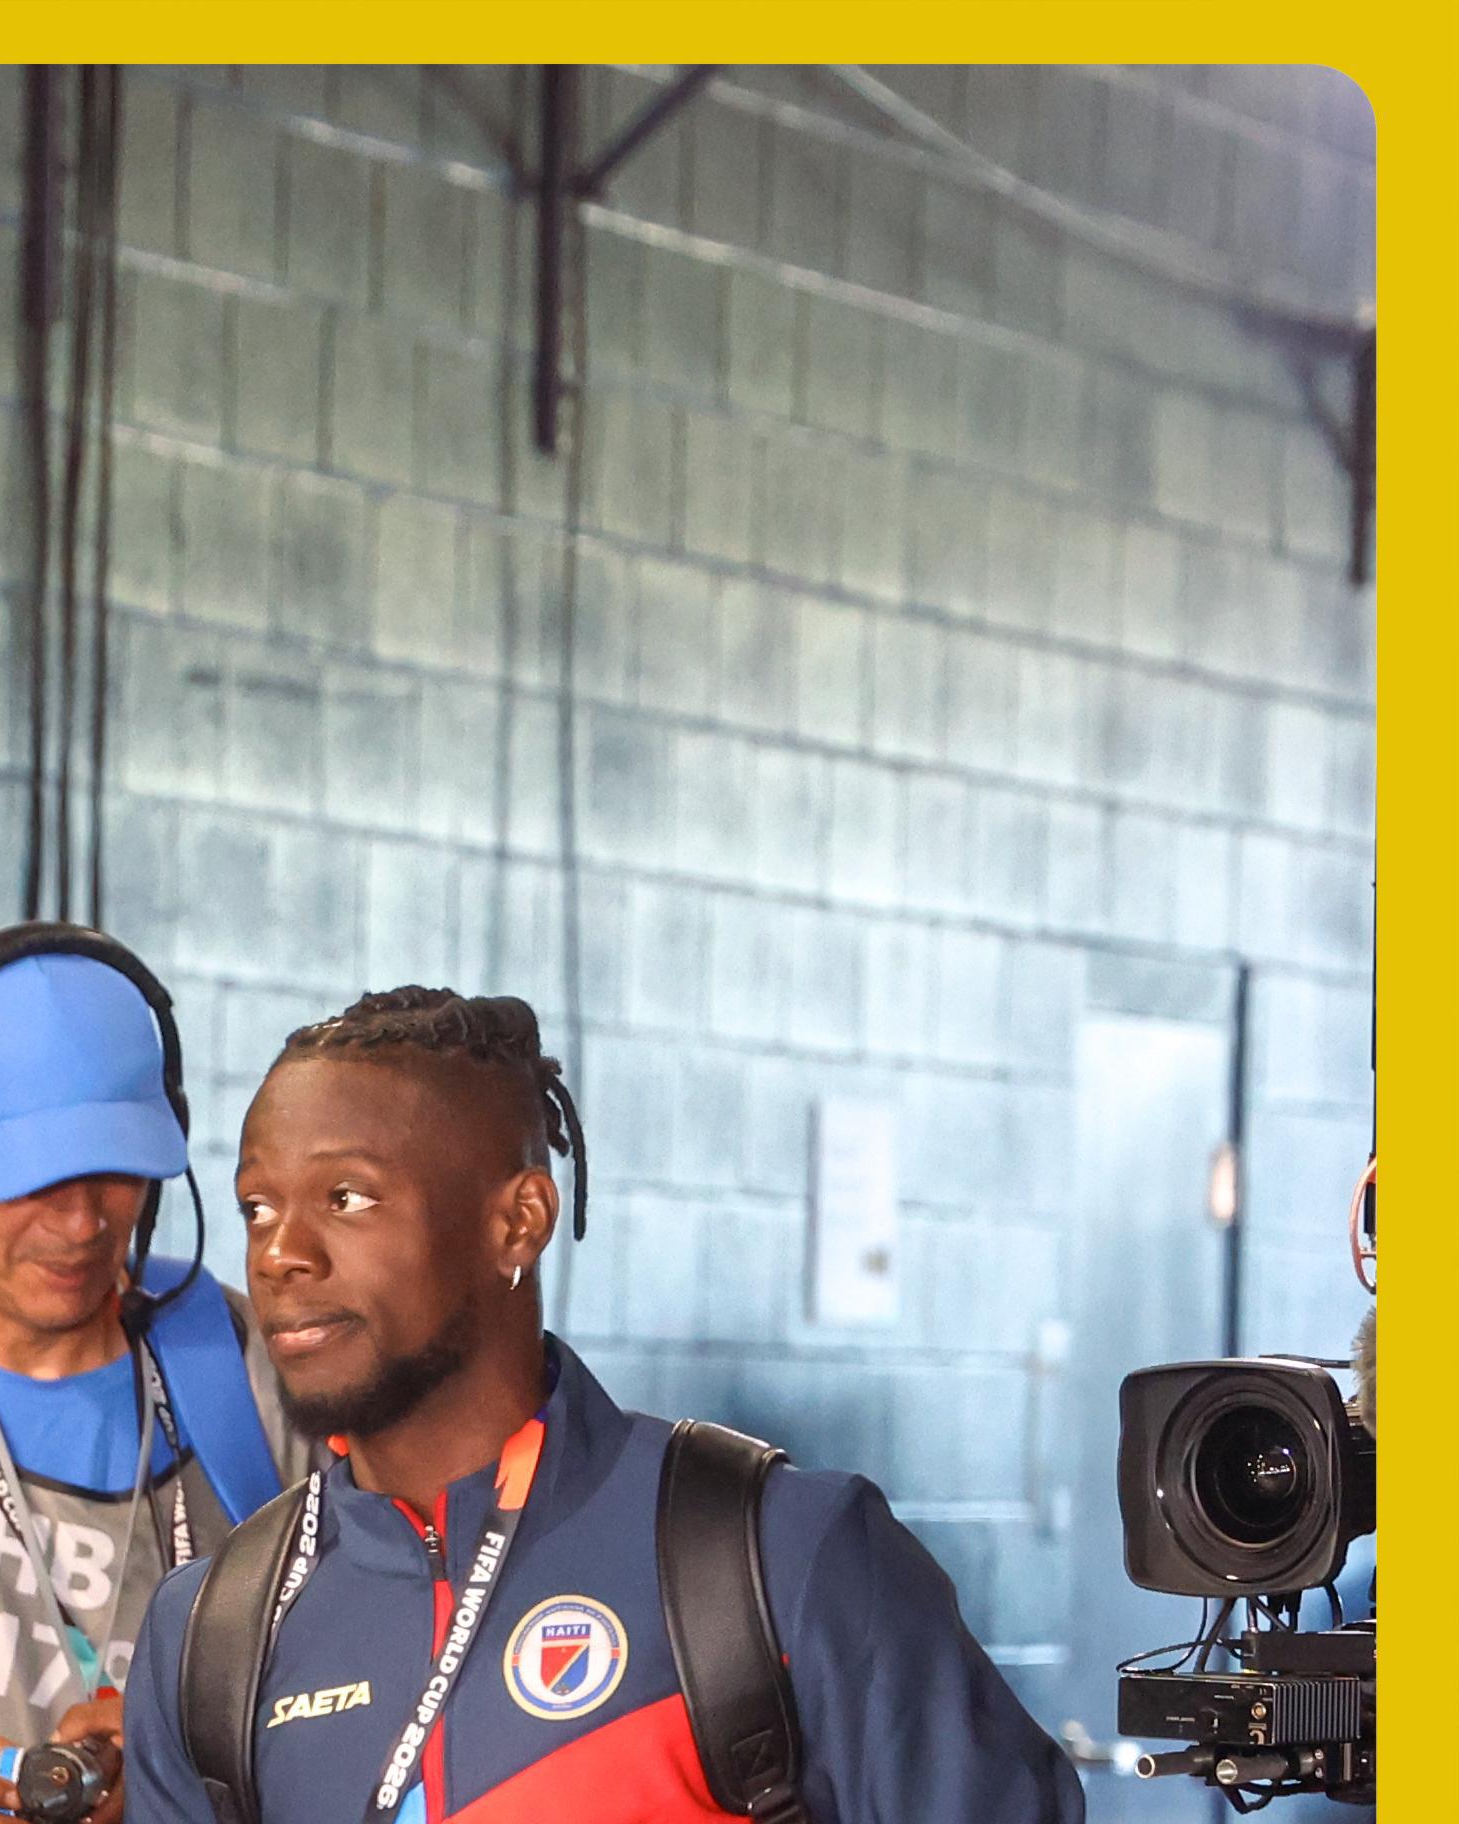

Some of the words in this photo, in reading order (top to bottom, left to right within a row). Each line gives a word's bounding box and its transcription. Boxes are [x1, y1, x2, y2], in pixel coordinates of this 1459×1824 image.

[279, 1556, 309, 1602] CUP
[299, 1470, 321, 1557] 2026
[469, 1530, 506, 1583] FIFA
[439, 1585, 487, 1675] WORLD
[545, 1625, 588, 1637] HAITI
[267, 1680, 372, 1728] SAETA
[416, 1675, 449, 1725] CUP
[377, 1722, 425, 1810] 2026
